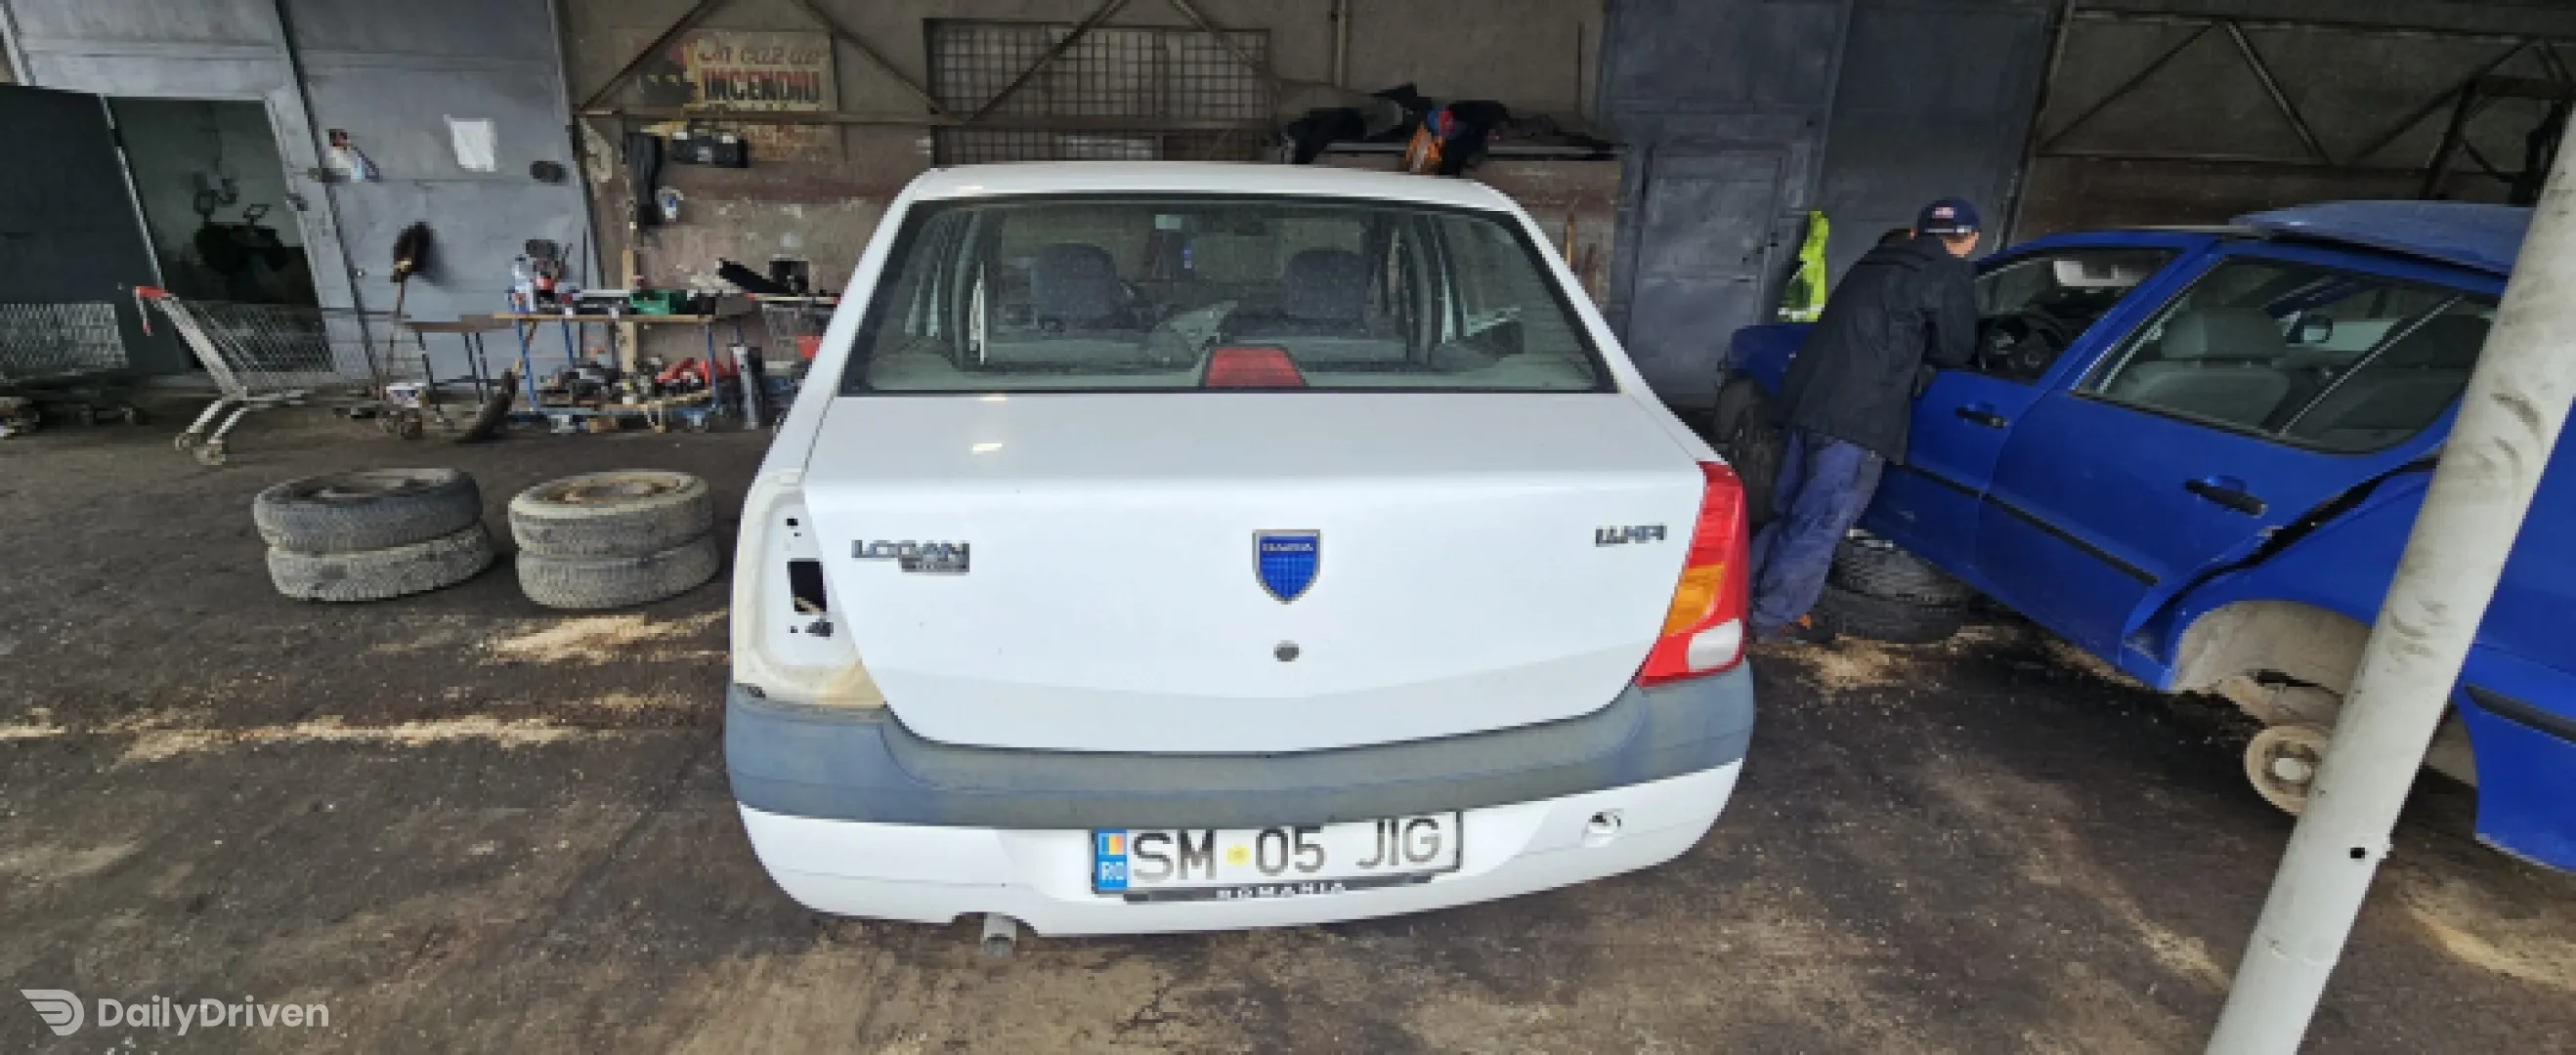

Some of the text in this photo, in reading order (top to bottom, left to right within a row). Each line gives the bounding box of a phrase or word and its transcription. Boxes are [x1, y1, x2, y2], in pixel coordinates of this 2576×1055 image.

[701, 69, 820, 102] INCENDIU
[851, 539, 970, 561] LOGAN
[1133, 817, 1442, 881] SM 05 JIG
[1216, 882, 1348, 901] ROMANIA
